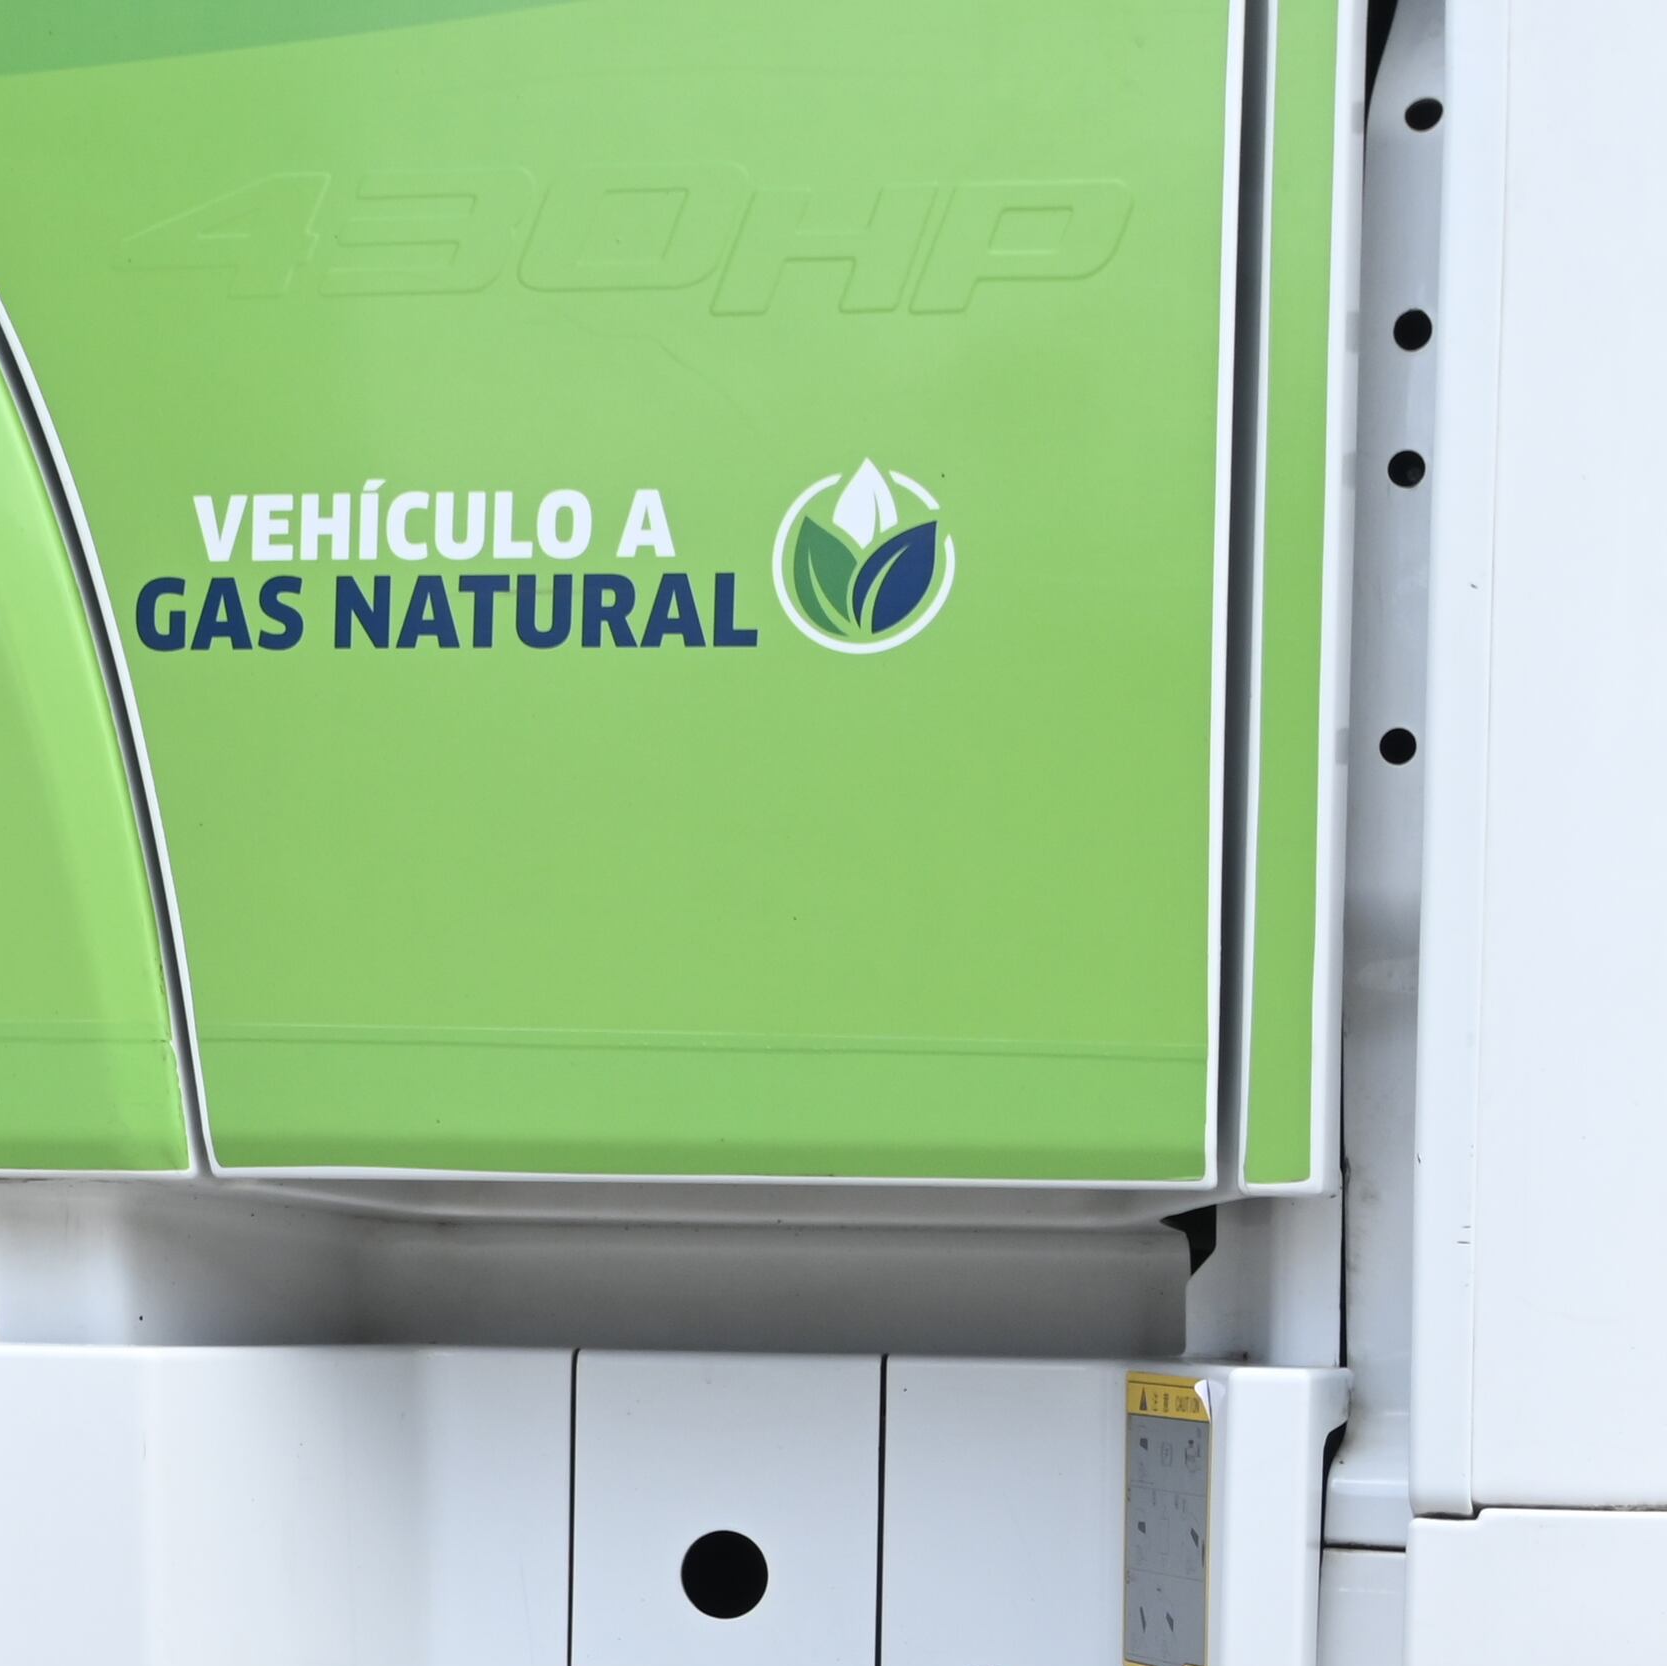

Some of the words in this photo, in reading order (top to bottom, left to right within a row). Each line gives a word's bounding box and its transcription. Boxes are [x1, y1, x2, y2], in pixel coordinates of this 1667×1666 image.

[193, 477, 592, 562] VEHÍCULO
[617, 489, 676, 558] A
[135, 574, 305, 652] GAS
[334, 571, 759, 650] NATURAL
